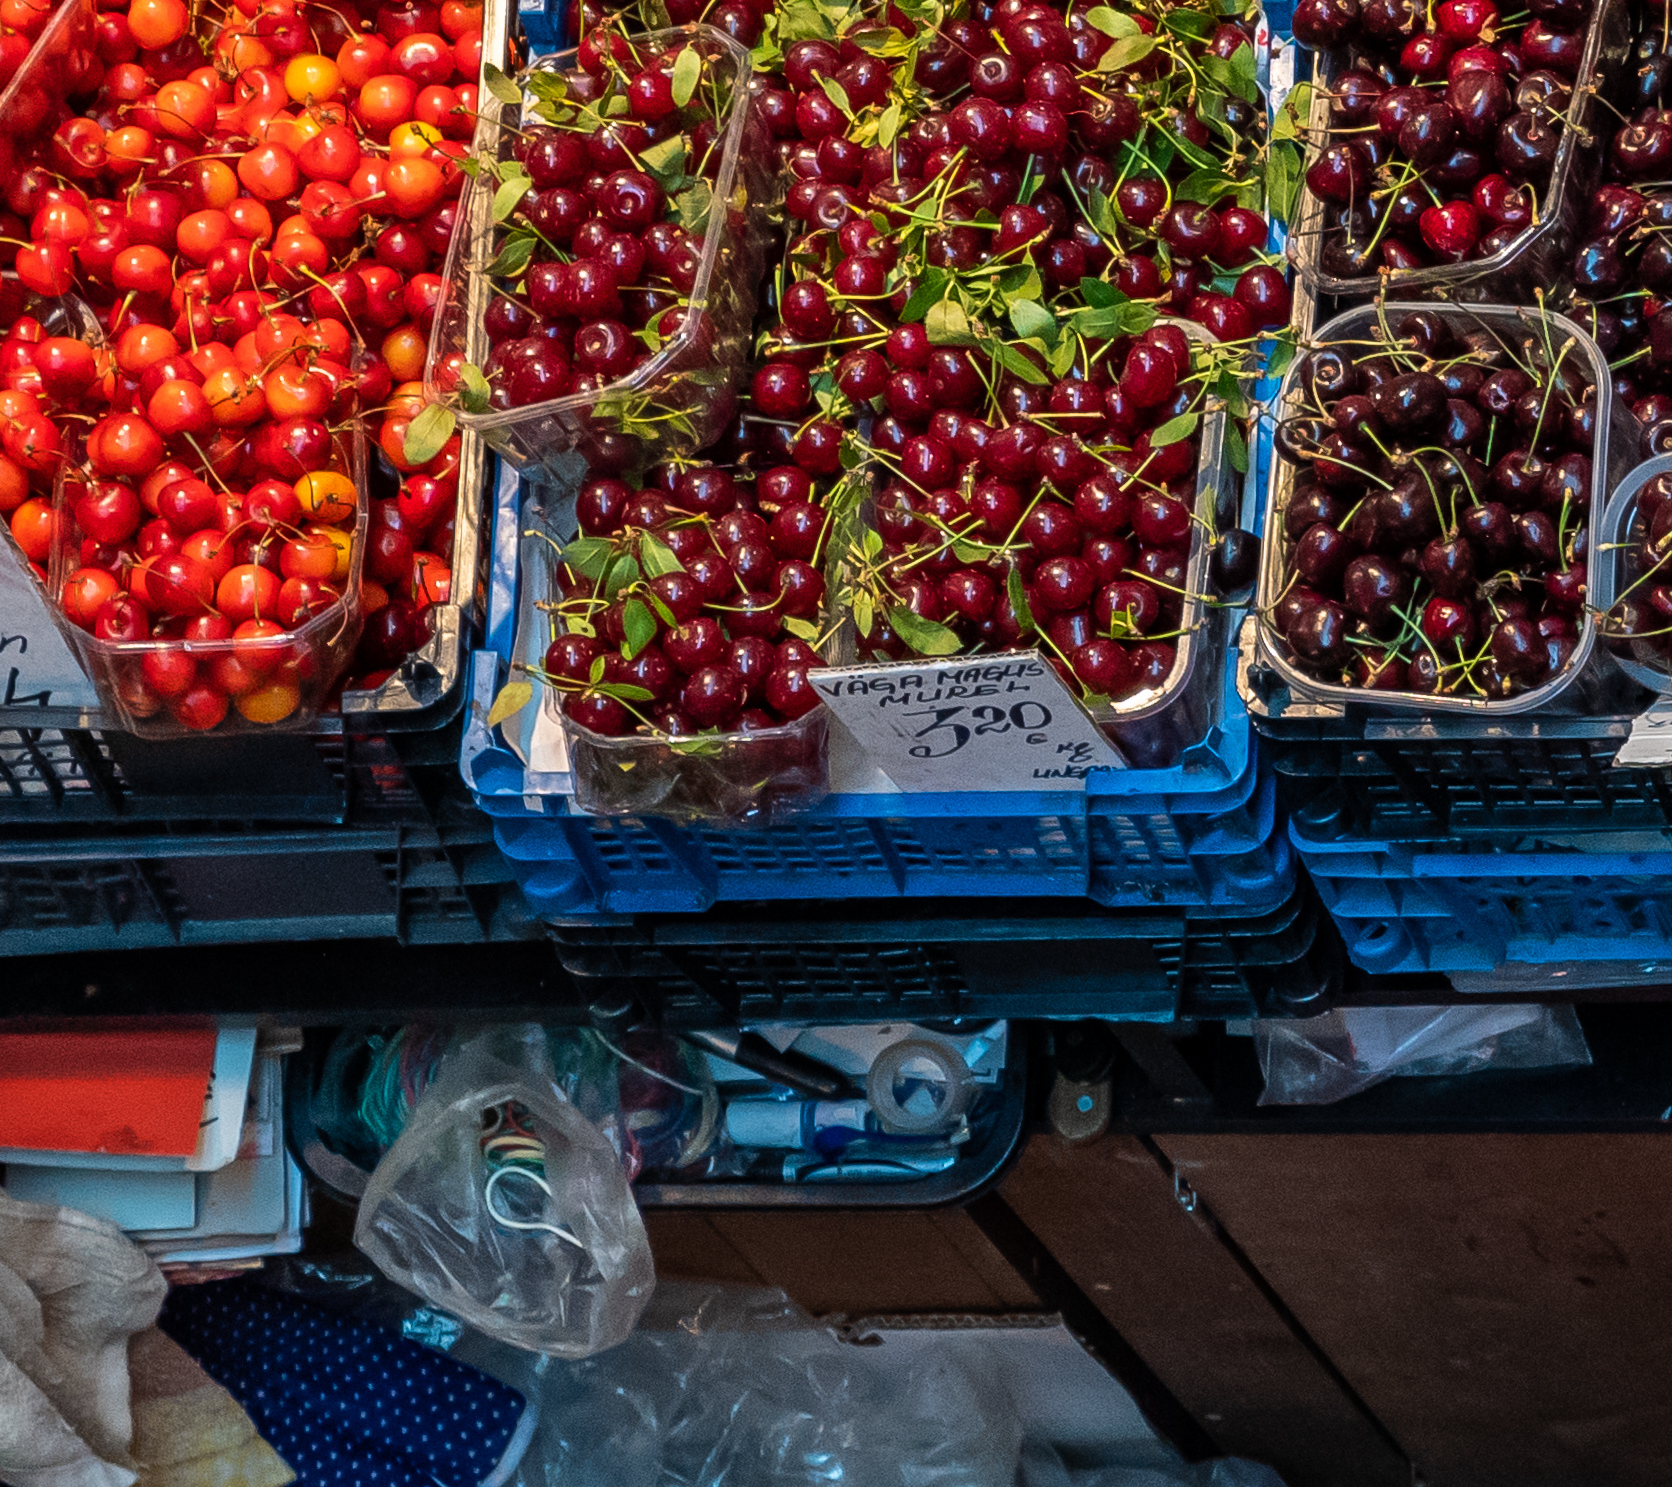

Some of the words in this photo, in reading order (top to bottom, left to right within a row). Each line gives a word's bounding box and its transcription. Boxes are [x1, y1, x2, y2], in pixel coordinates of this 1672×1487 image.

[819, 675, 922, 698] VÄGA
[937, 663, 1045, 685] MAGUS
[879, 680, 1030, 708] MUREL
